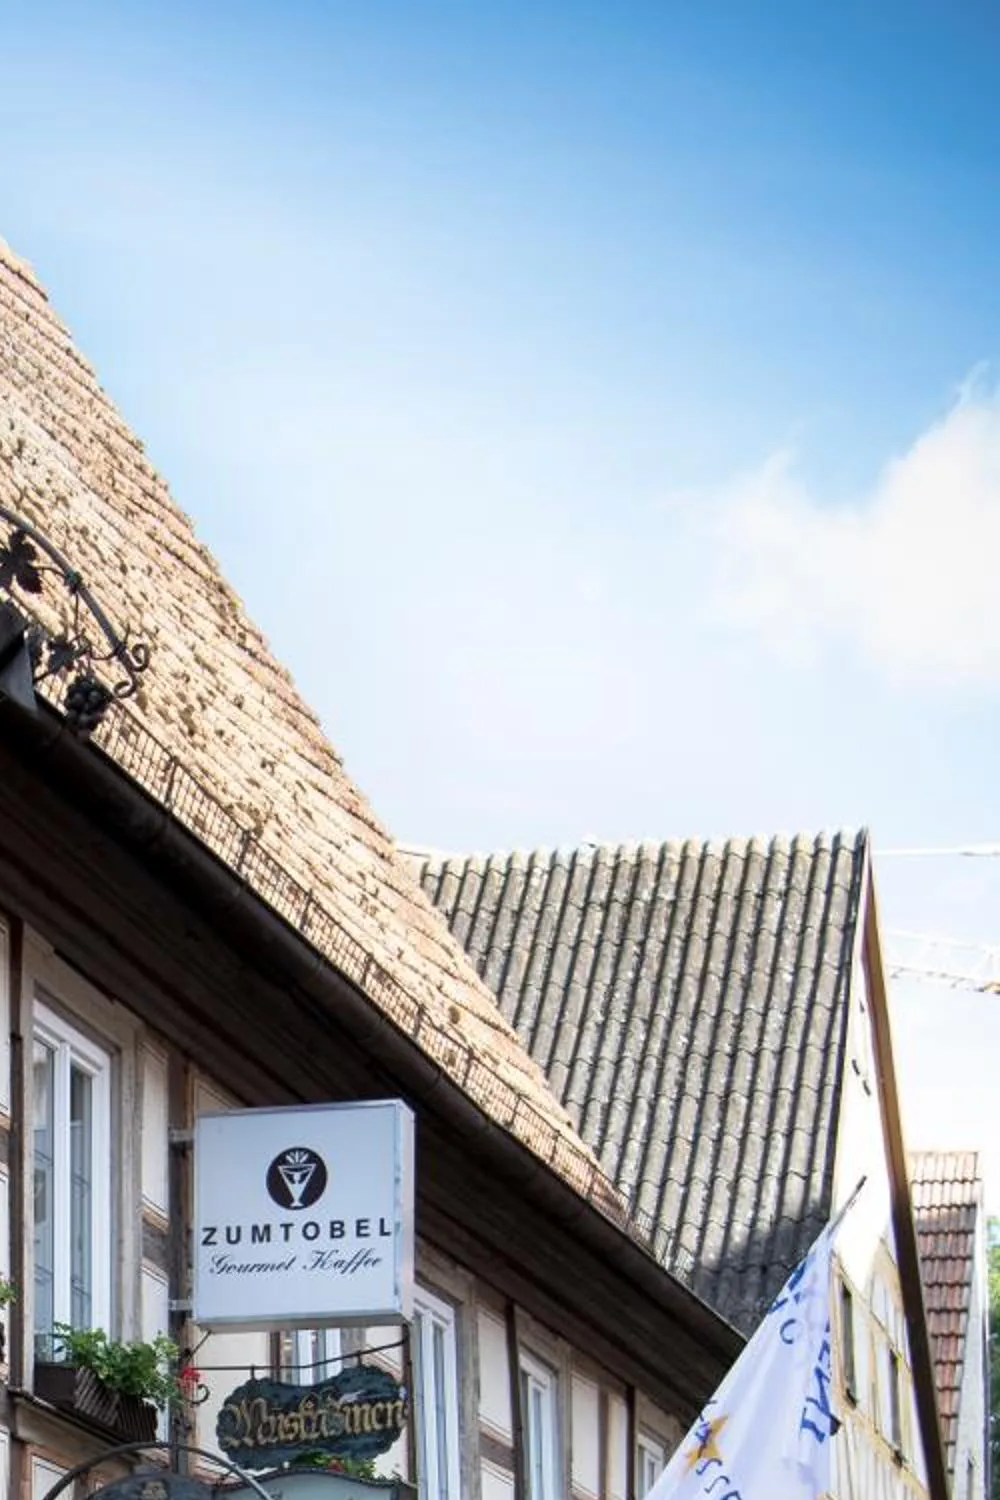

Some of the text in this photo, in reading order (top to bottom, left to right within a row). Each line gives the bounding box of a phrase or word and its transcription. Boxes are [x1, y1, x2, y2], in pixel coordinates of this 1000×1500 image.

[201, 1217, 392, 1246] ZUMTOBEL
[209, 1246, 383, 1276] Gourmet Kaffee
